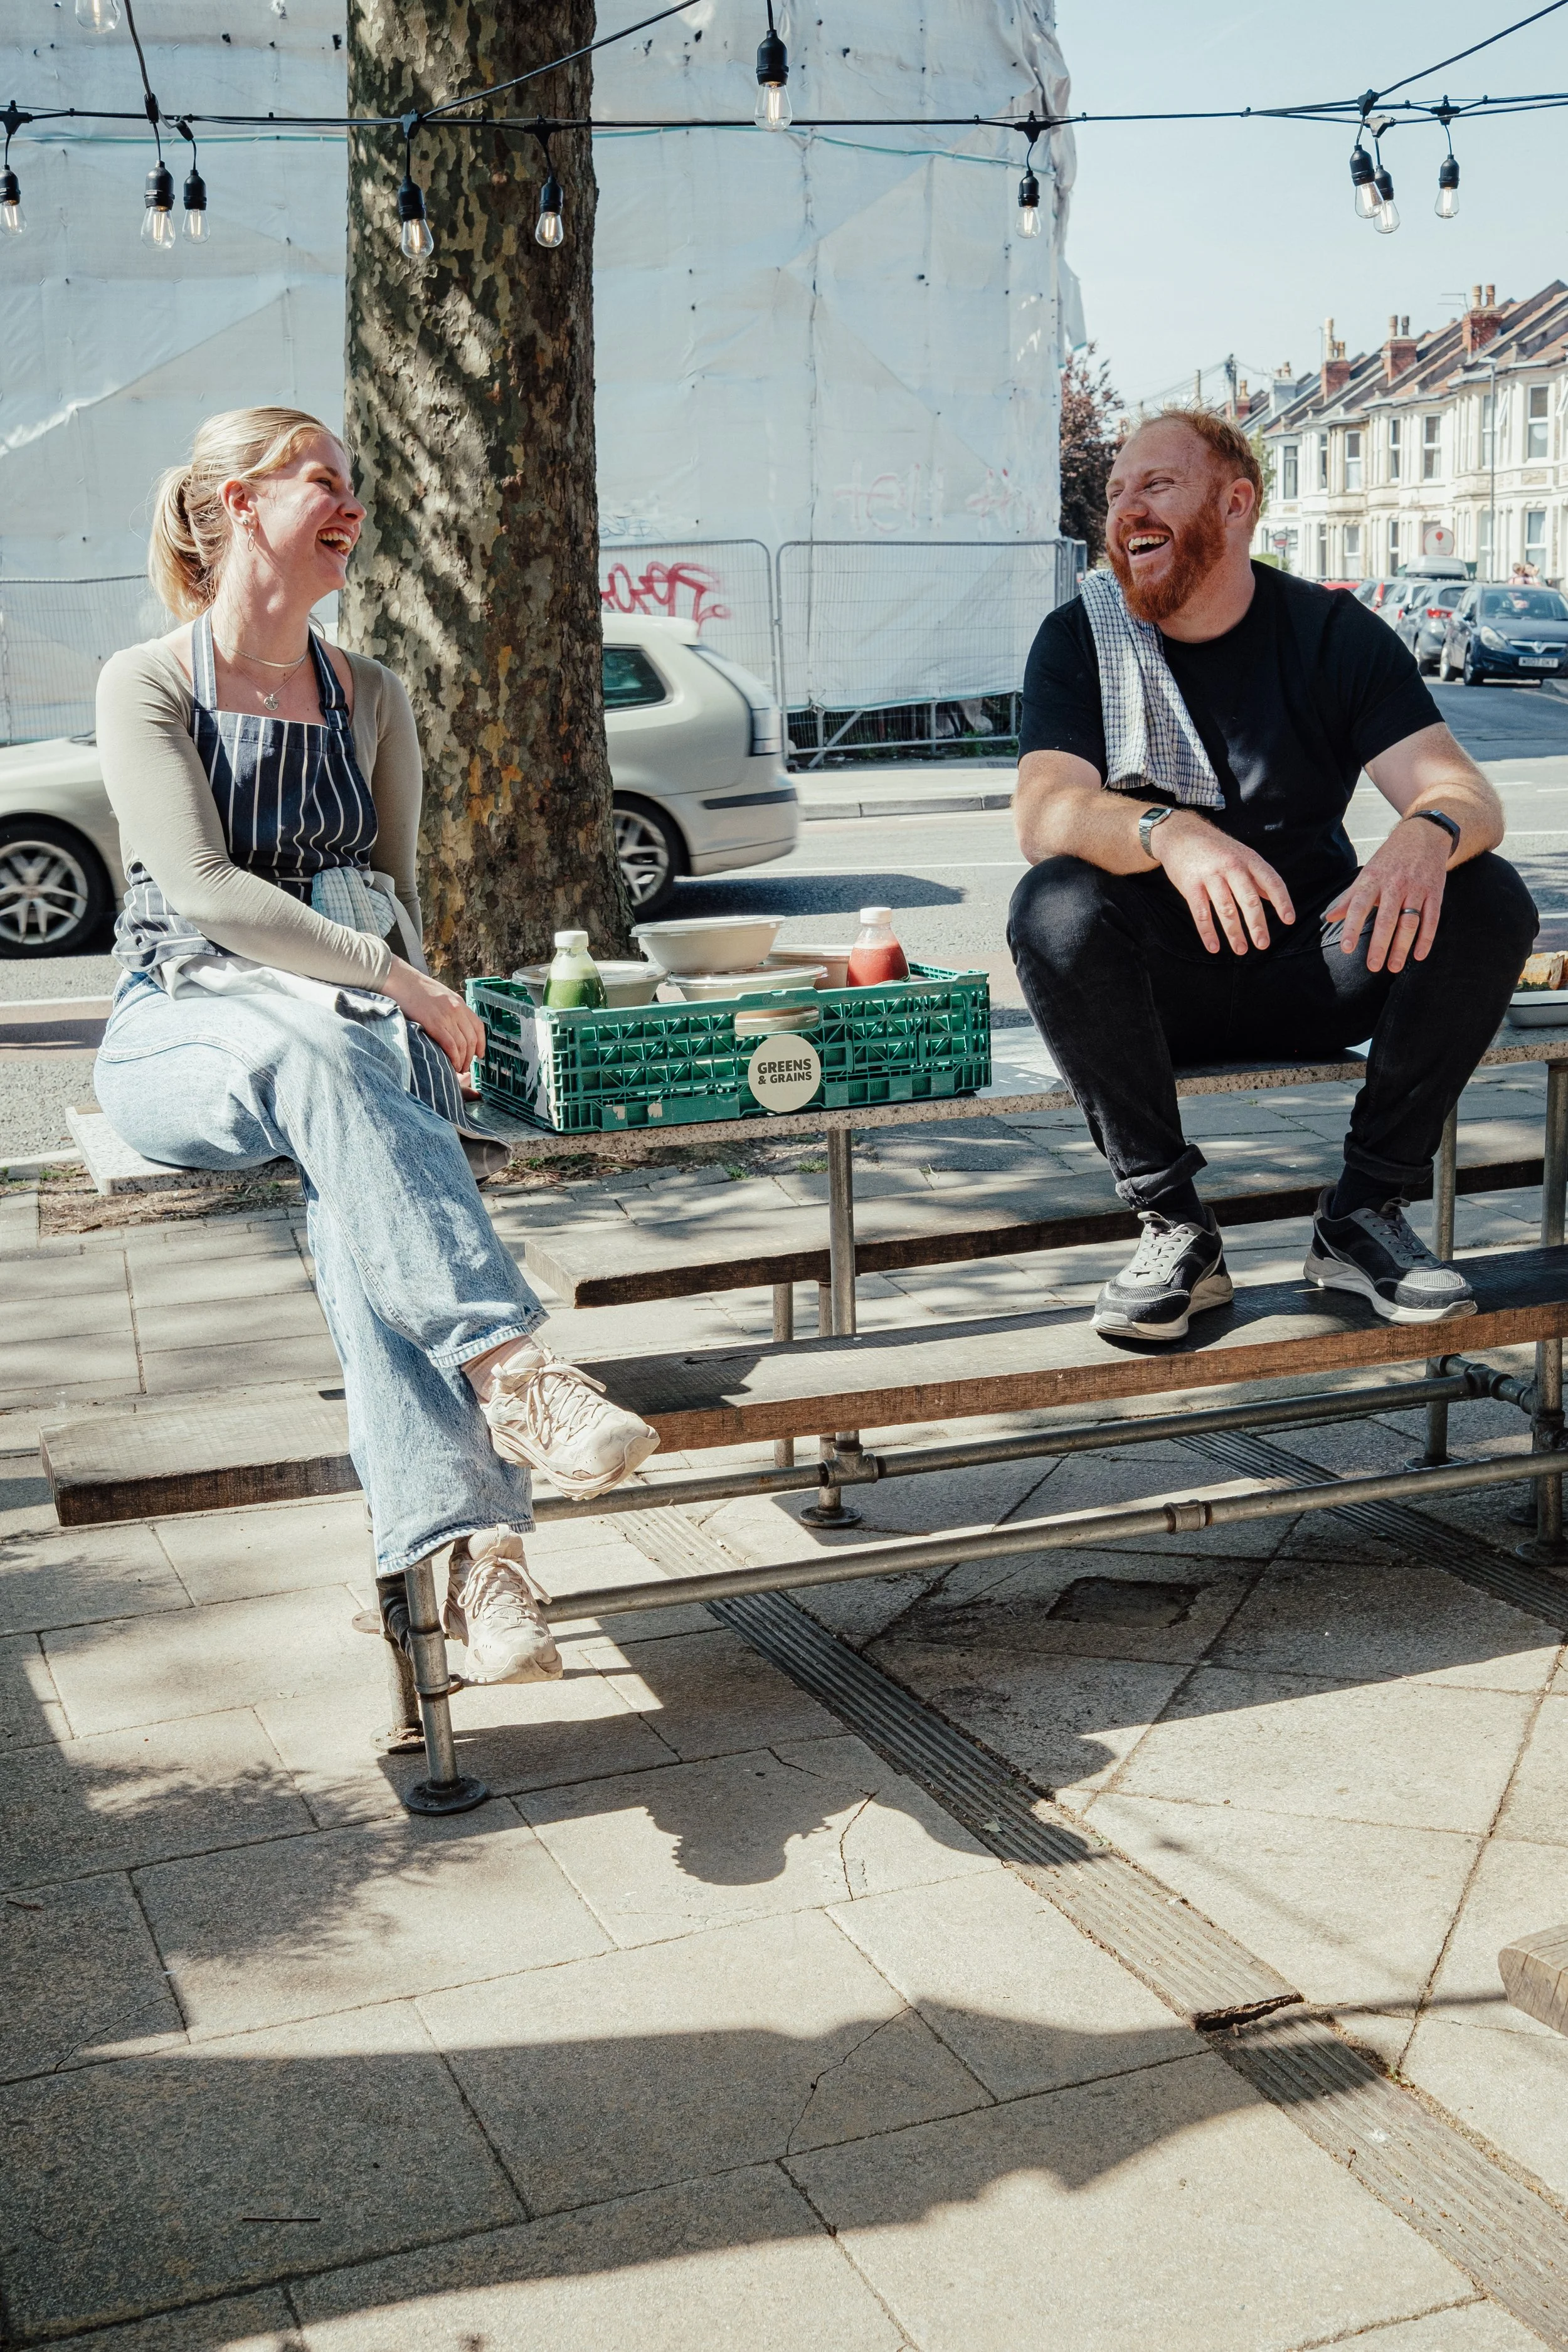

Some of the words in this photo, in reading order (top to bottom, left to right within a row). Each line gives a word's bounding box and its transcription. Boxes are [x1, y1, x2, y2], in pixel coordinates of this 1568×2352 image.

[757, 1058, 812, 1074] GREENS
[758, 1076, 766, 1085] &
[770, 1071, 812, 1084] GRAINS
